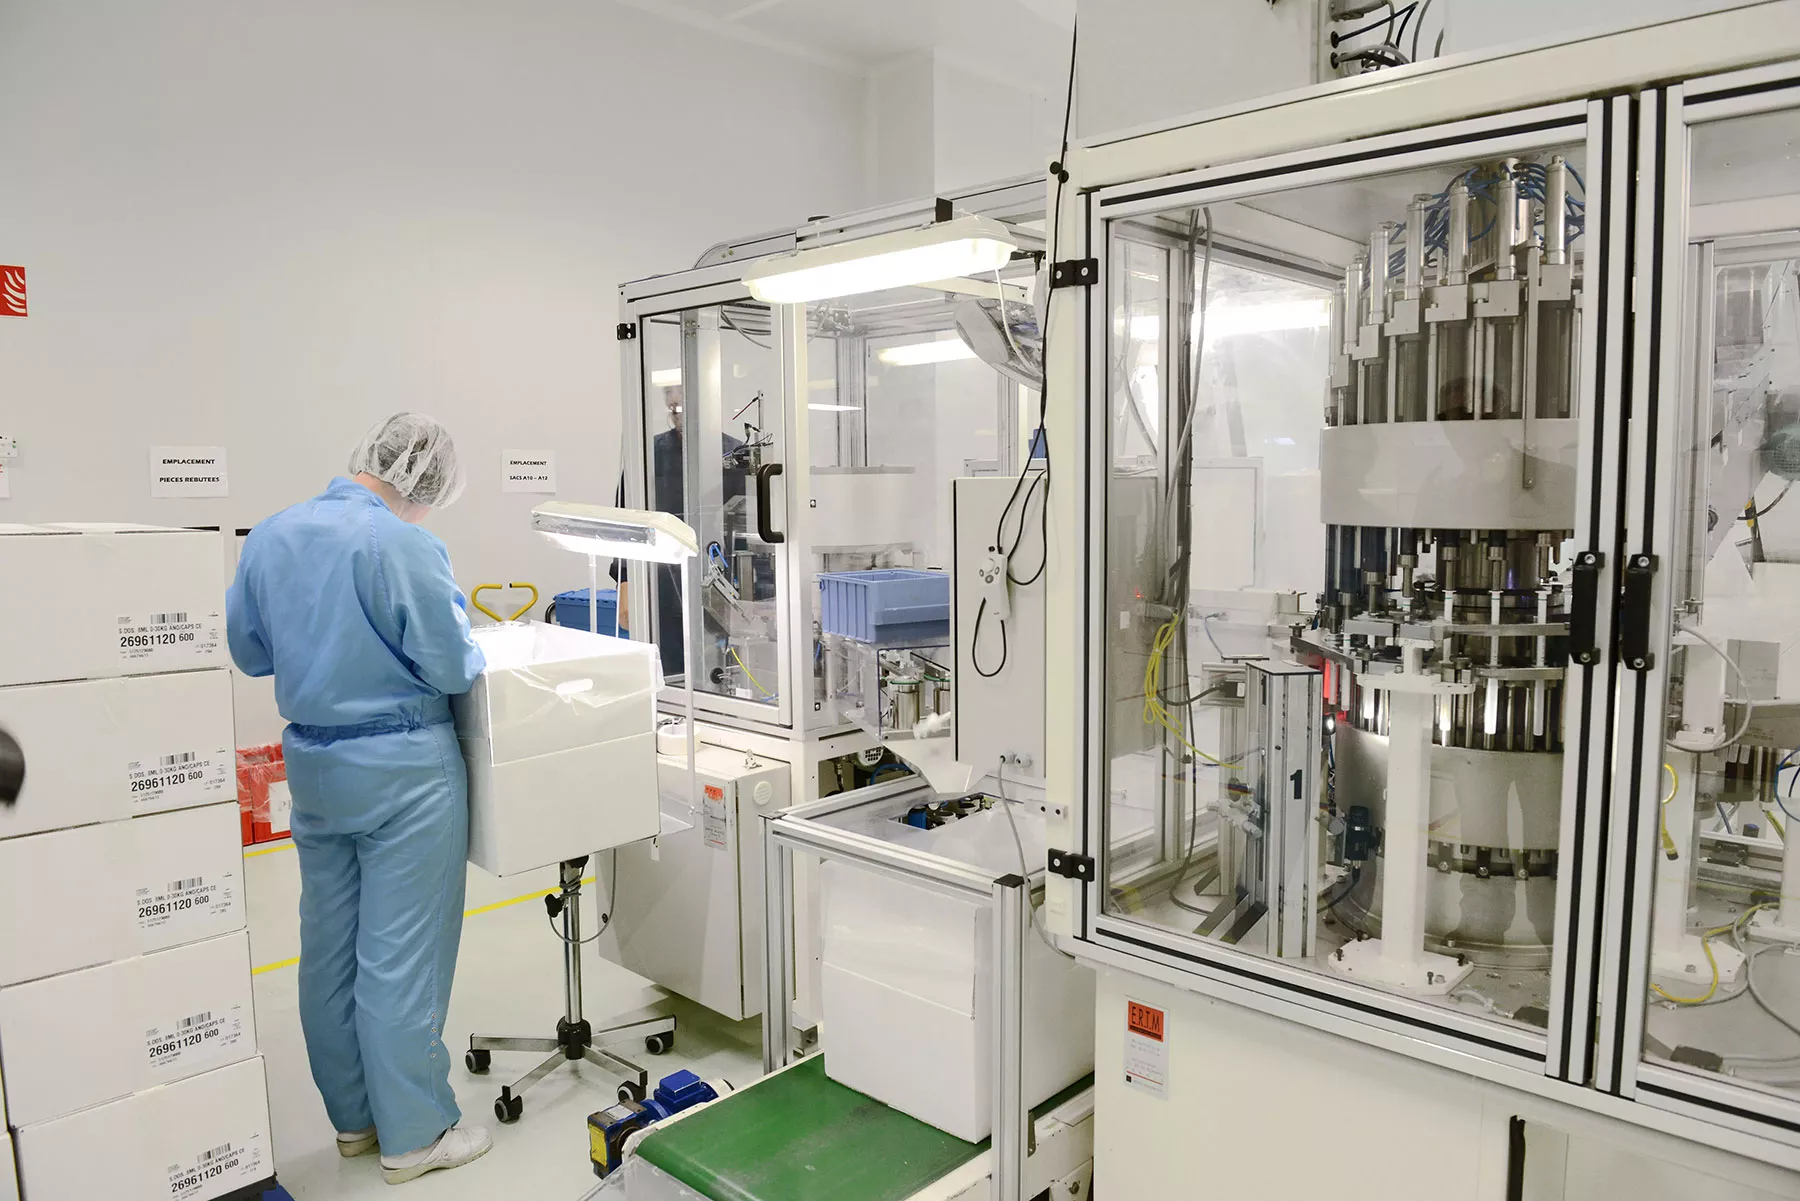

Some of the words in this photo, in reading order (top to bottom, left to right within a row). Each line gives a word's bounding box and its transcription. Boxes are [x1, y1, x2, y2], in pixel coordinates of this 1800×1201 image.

[120, 633, 176, 648] 26961120
[178, 632, 194, 641] 600
[131, 773, 186, 792] 26961120
[187, 770, 203, 781] 600
[1290, 769, 1302, 800] 1
[138, 898, 192, 918] 26961120
[194, 895, 210, 906] 600
[149, 1033, 202, 1058] 26961120
[204, 1028, 219, 1039] 600
[171, 1164, 223, 1193] 26961120
[224, 1158, 239, 1170] 600
